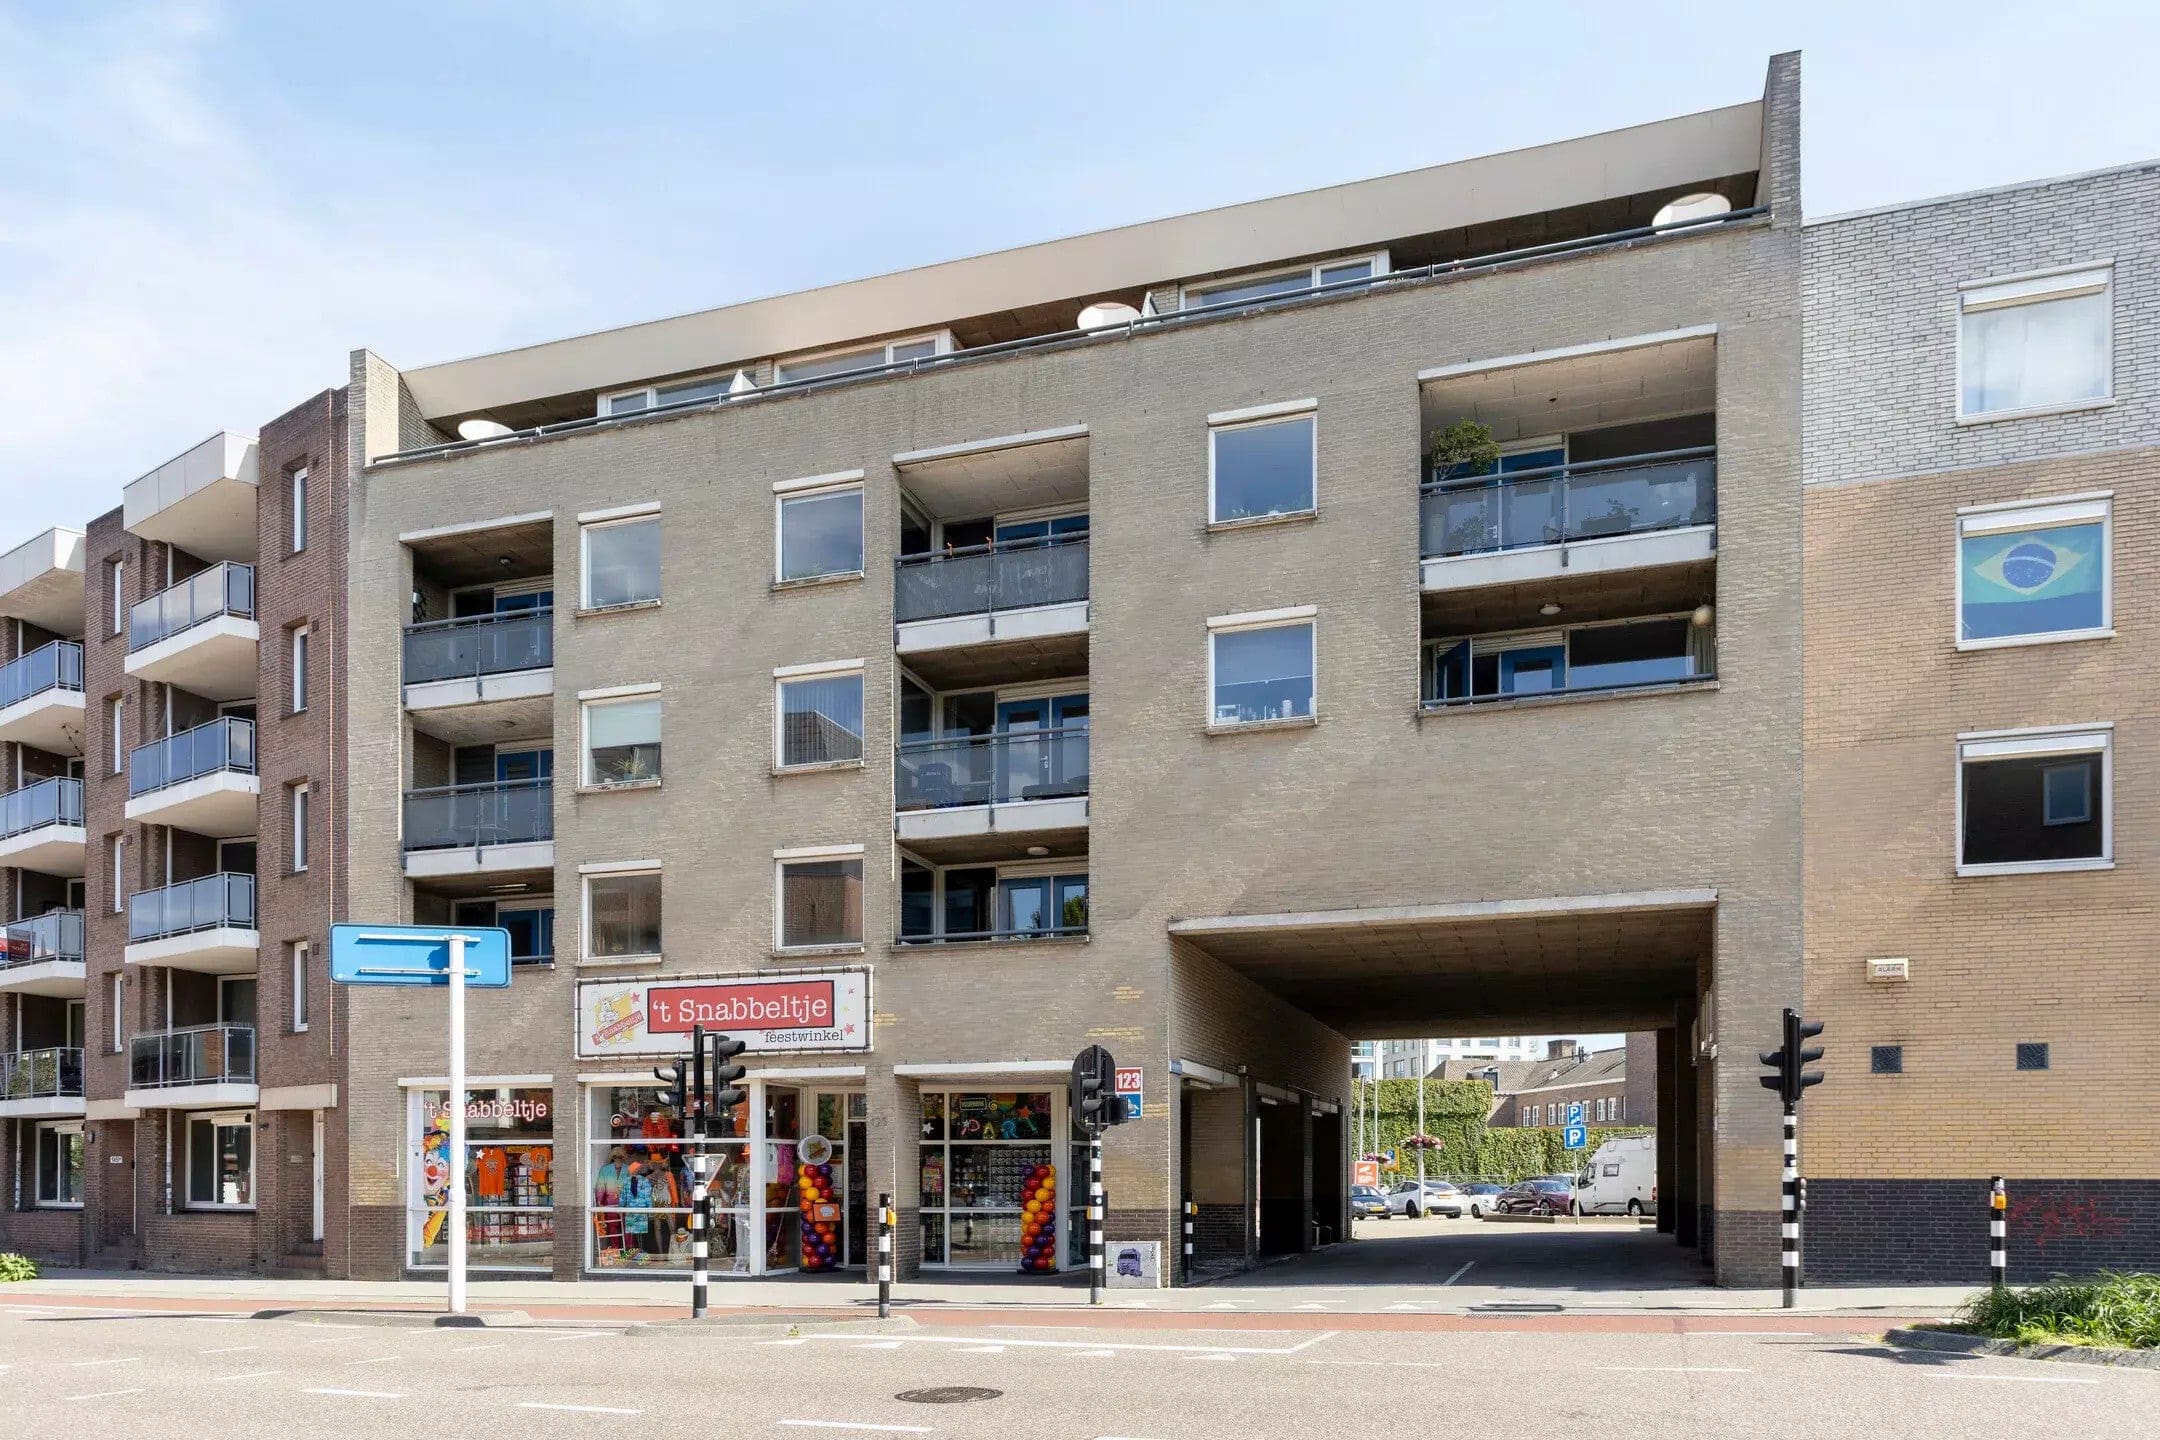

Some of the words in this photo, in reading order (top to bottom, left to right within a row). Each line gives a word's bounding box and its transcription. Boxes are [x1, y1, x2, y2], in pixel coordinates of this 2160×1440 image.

[679, 995, 828, 1024] Snabbeltje
[765, 1029, 844, 1043] feestwinkel
[1116, 1072, 1141, 1089] 123
[442, 1099, 548, 1122] Sabbeltje
[1570, 1106, 1579, 1118] P
[1569, 1129, 1582, 1146] P
